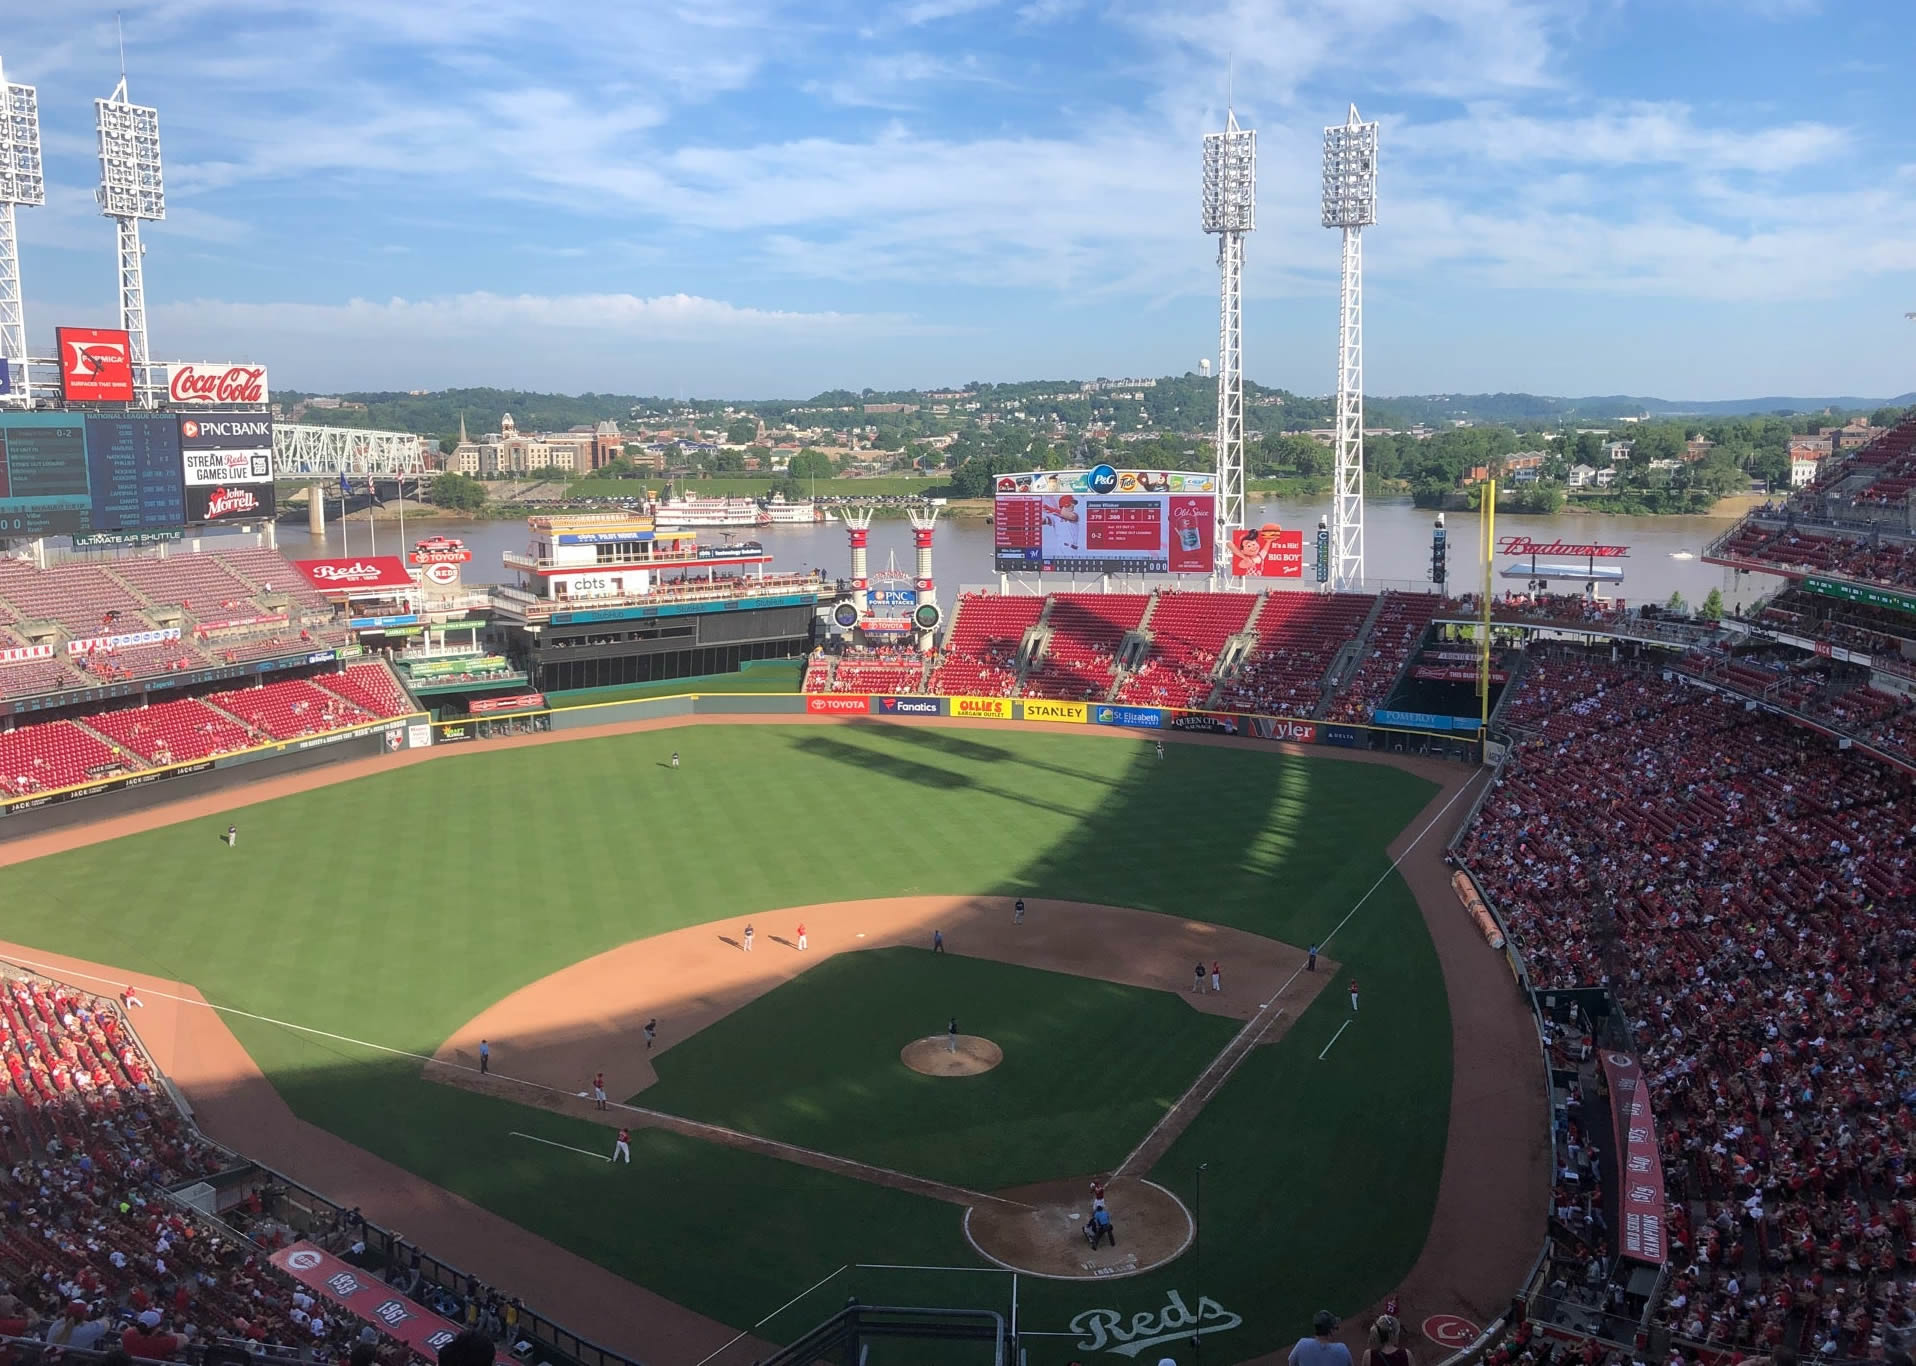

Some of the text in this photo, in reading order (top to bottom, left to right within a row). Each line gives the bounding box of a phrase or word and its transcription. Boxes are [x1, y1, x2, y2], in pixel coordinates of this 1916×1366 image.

[171, 366, 266, 402] Coca-Cola
[56, 429, 72, 438] 0-2
[188, 453, 249, 468] STREAM Reds
[197, 468, 248, 480] GAMES LIVE
[1095, 474, 1115, 485] P&G
[1120, 478, 1136, 488] Tide
[225, 488, 245, 500] John
[204, 493, 260, 520] Morrell
[1174, 507, 1208, 516] Old Spice
[0, 520, 8, 530] 0
[14, 519, 20, 529] 0
[77, 536, 122, 546] ULTIMATE
[140, 532, 180, 540] SHUTTLE
[1500, 536, 1627, 556] Budweiser
[1284, 554, 1299, 562] BOY
[313, 562, 382, 580] Reds
[574, 577, 606, 591] cbts
[886, 592, 908, 601] PNC
[676, 604, 705, 613] StubHub
[592, 610, 624, 620] StubHub
[1816, 644, 1830, 654] JACK
[827, 700, 864, 709] TOYOTA
[897, 702, 936, 712] Fanatics
[960, 700, 1002, 712] OLLIE'S
[1028, 705, 1082, 718] STANLEY
[1124, 712, 1160, 722] Elizabeth
[1385, 711, 1436, 723] POMEROY
[1176, 717, 1201, 726] QUEEN
[1250, 718, 1312, 740] Wyler
[90, 766, 104, 774] JACK
[177, 766, 193, 775] JACK
[126, 777, 142, 786] JACK
[70, 788, 88, 798] JACK
[12, 802, 30, 812] JACK
[1626, 1212, 1641, 1252] WORLD SERIES
[1642, 1214, 1660, 1258] CHAMPIONS
[328, 1272, 358, 1294] 1933
[376, 1302, 408, 1324] 1961
[1070, 1289, 1243, 1358] Reds
